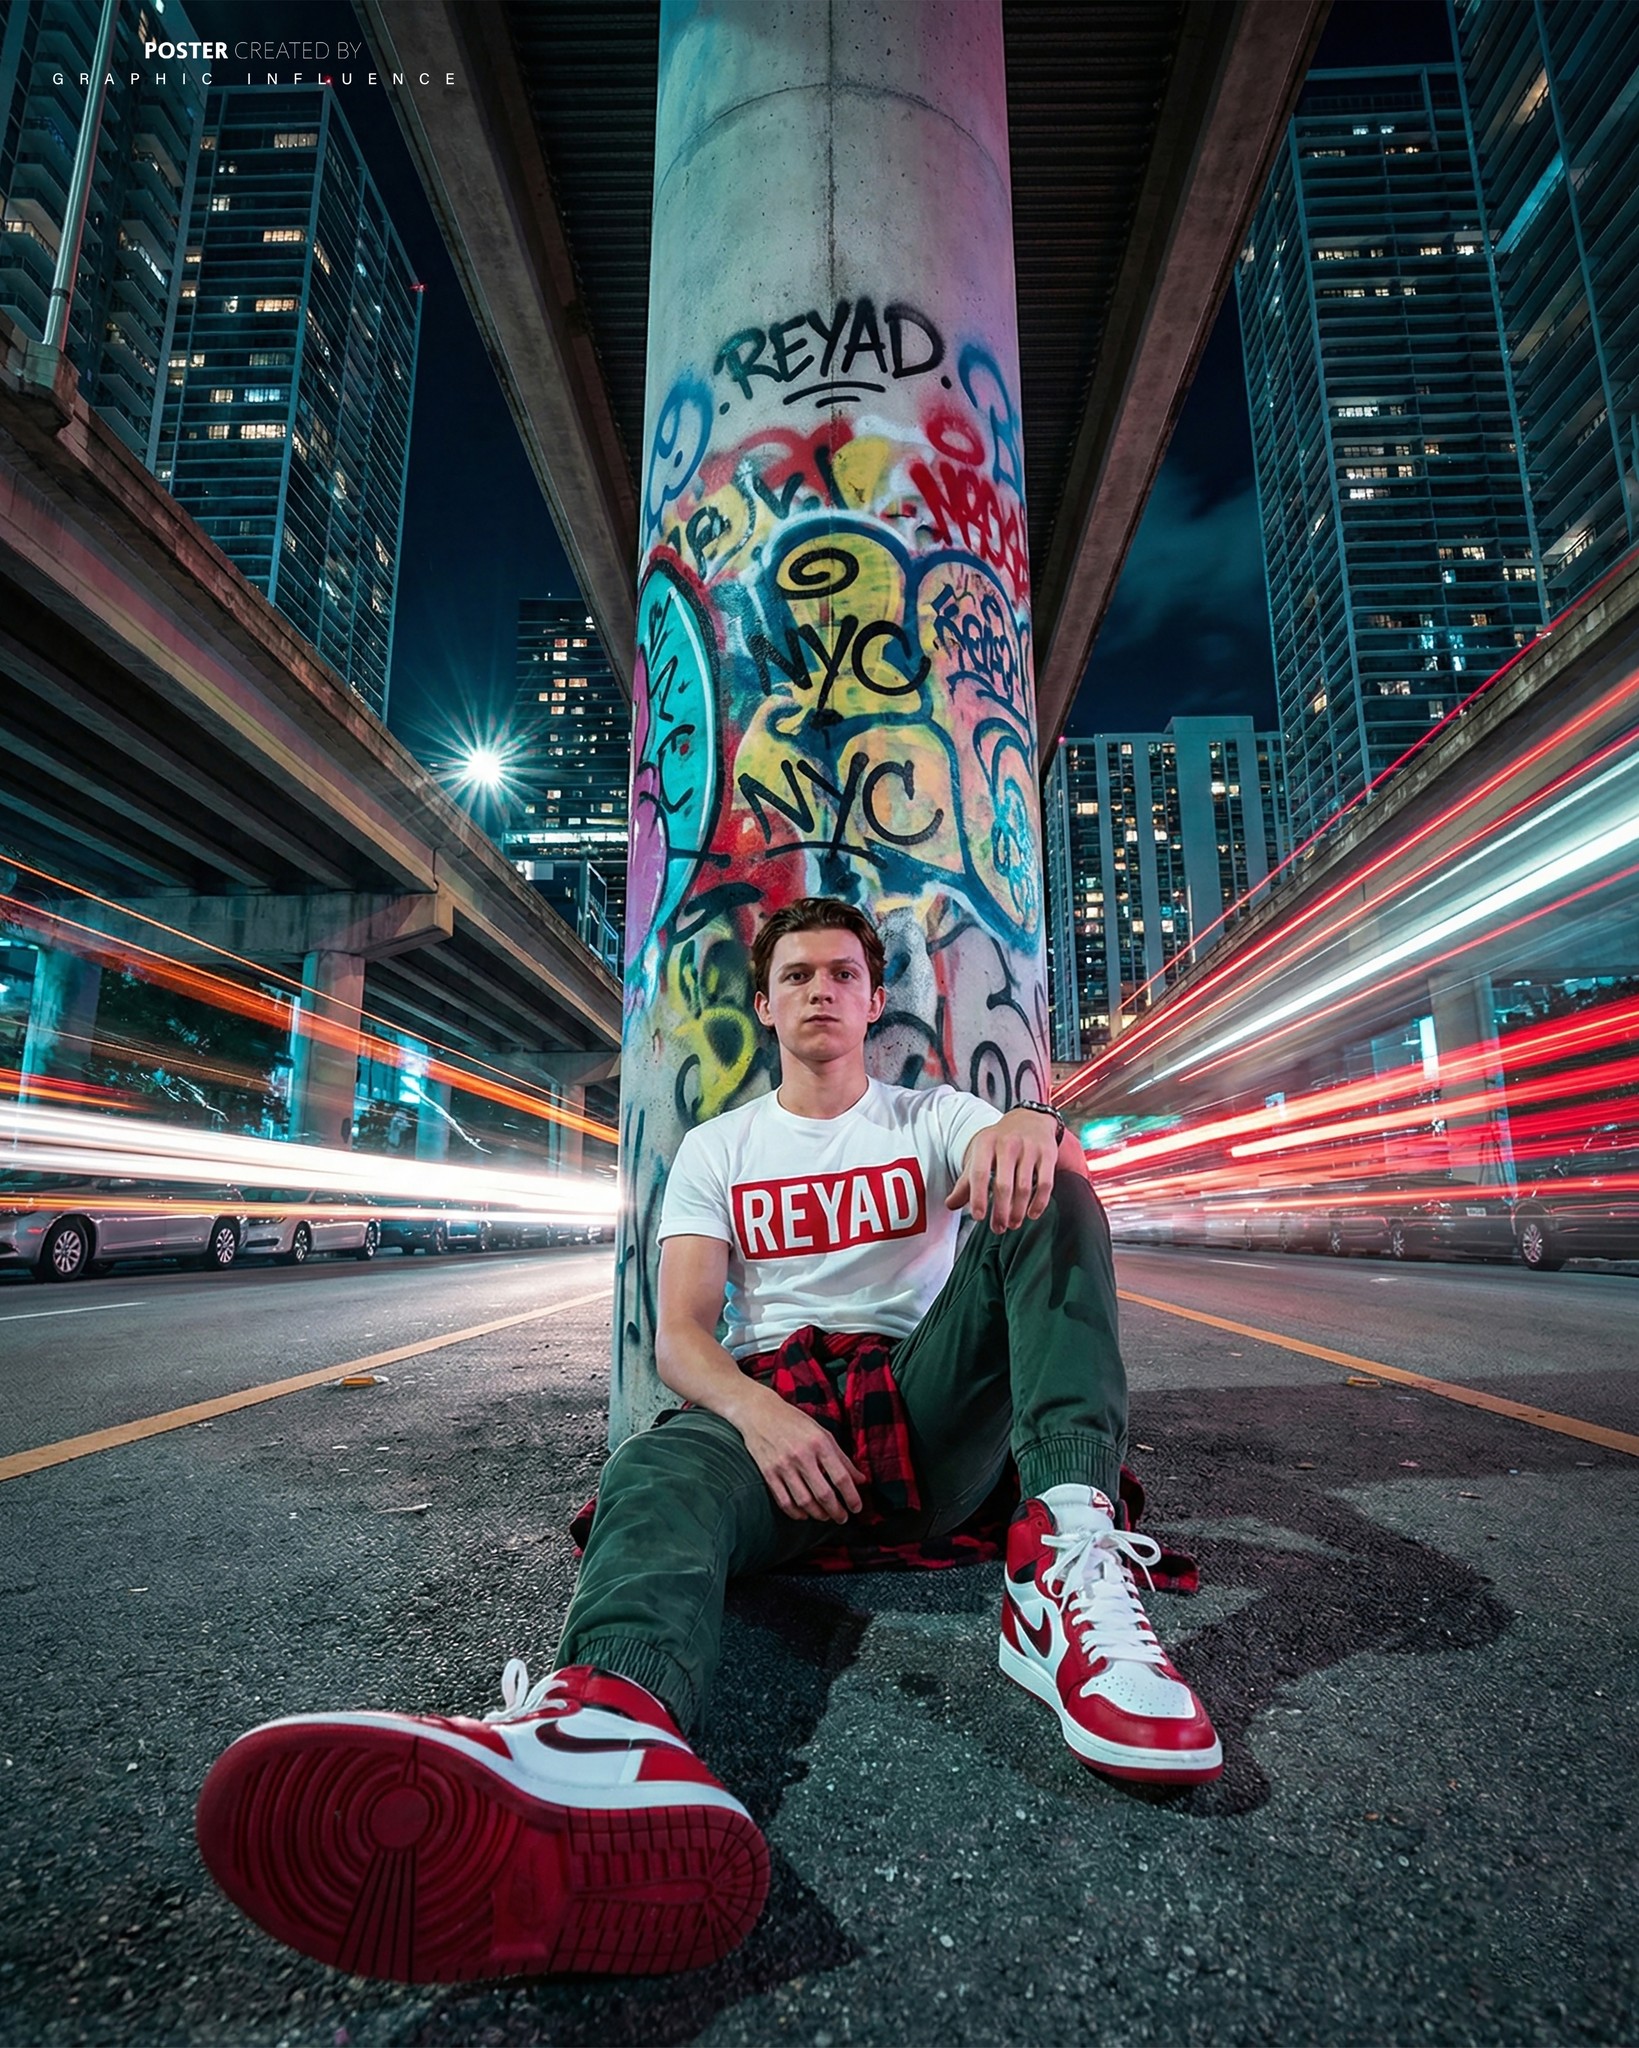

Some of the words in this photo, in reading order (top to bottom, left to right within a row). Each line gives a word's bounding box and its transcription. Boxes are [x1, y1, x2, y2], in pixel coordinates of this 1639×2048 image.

[747, 614, 931, 711] NYC
[738, 752, 944, 858] NYC
[742, 1167, 919, 1254] REYAD
